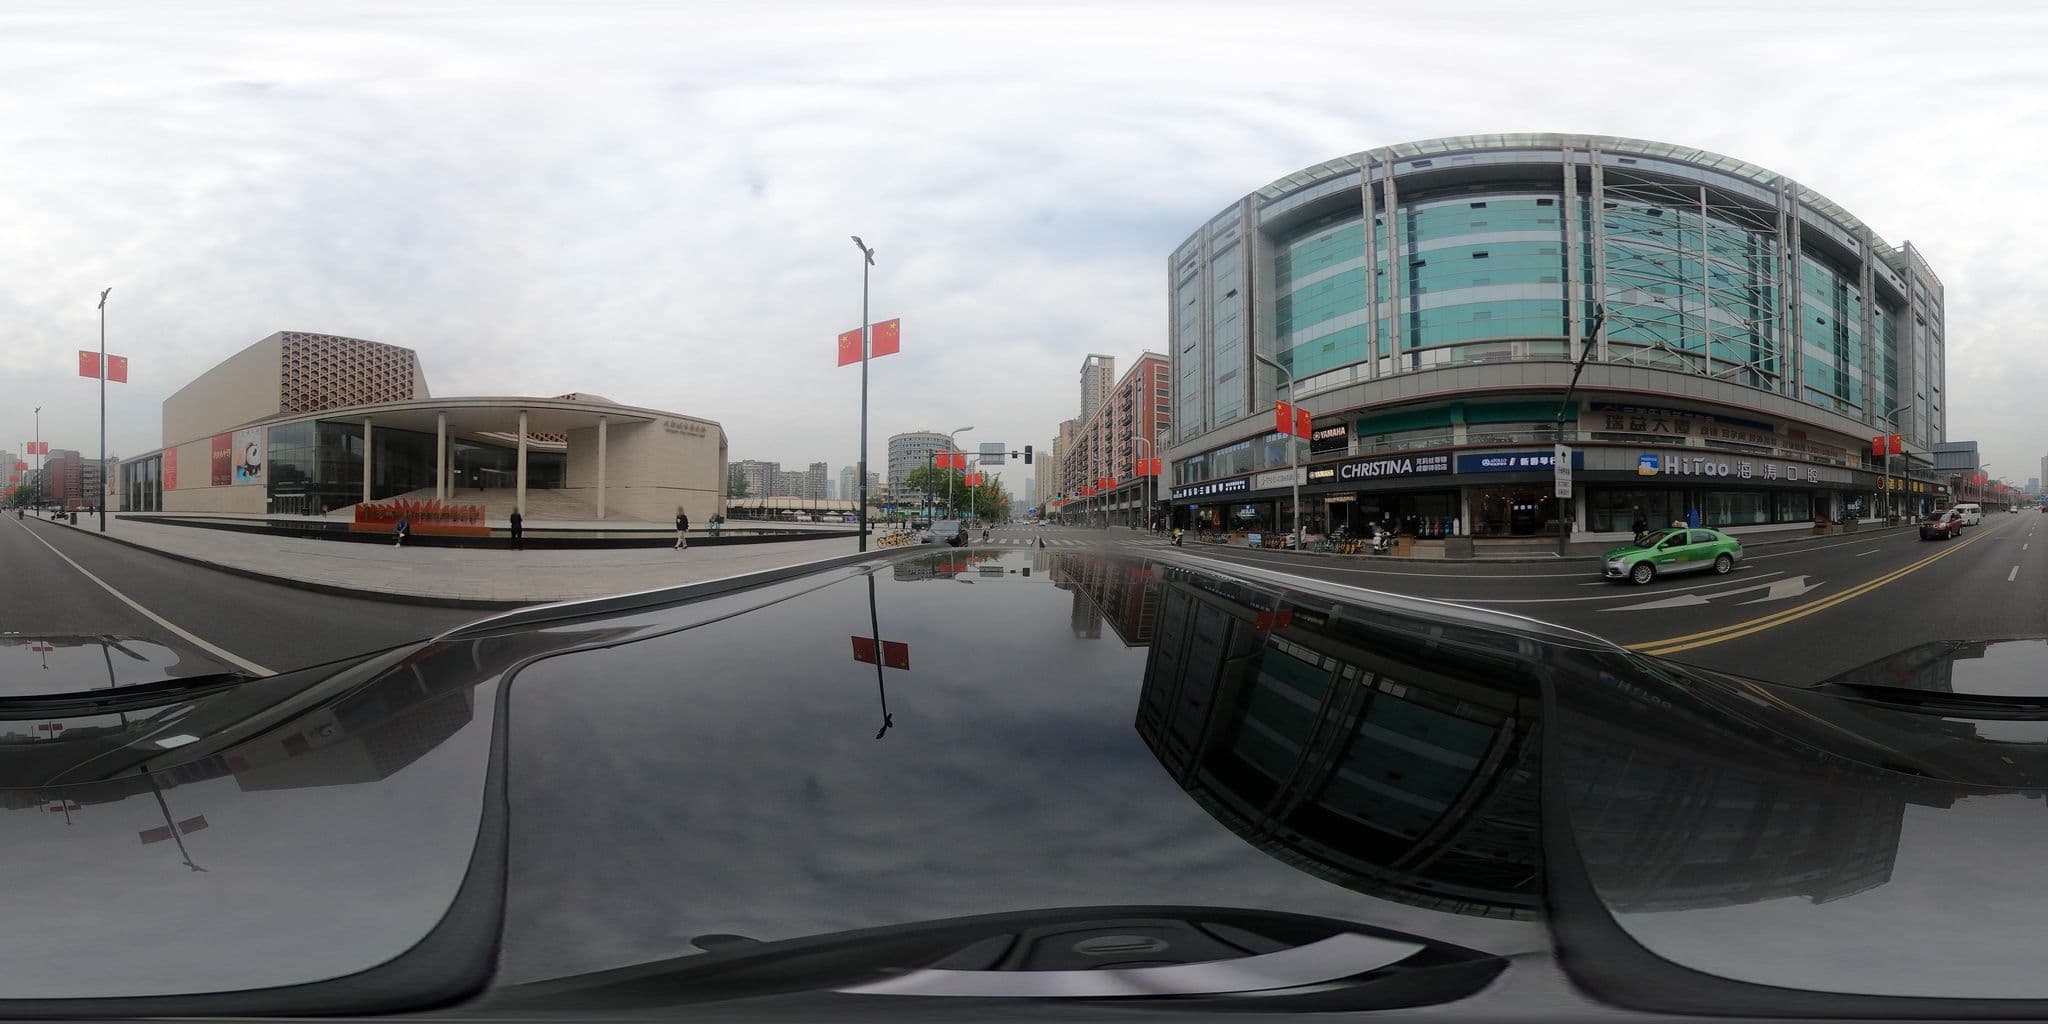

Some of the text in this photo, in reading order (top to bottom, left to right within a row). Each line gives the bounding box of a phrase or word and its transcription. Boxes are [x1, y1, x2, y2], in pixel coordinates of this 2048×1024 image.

[1320, 427, 1345, 439] YAMAHA
[1605, 413, 1691, 434] 瑞益大厦
[1341, 458, 1413, 479] CHRISTINA
[1664, 455, 1818, 483] HiTao 海涛口腔
